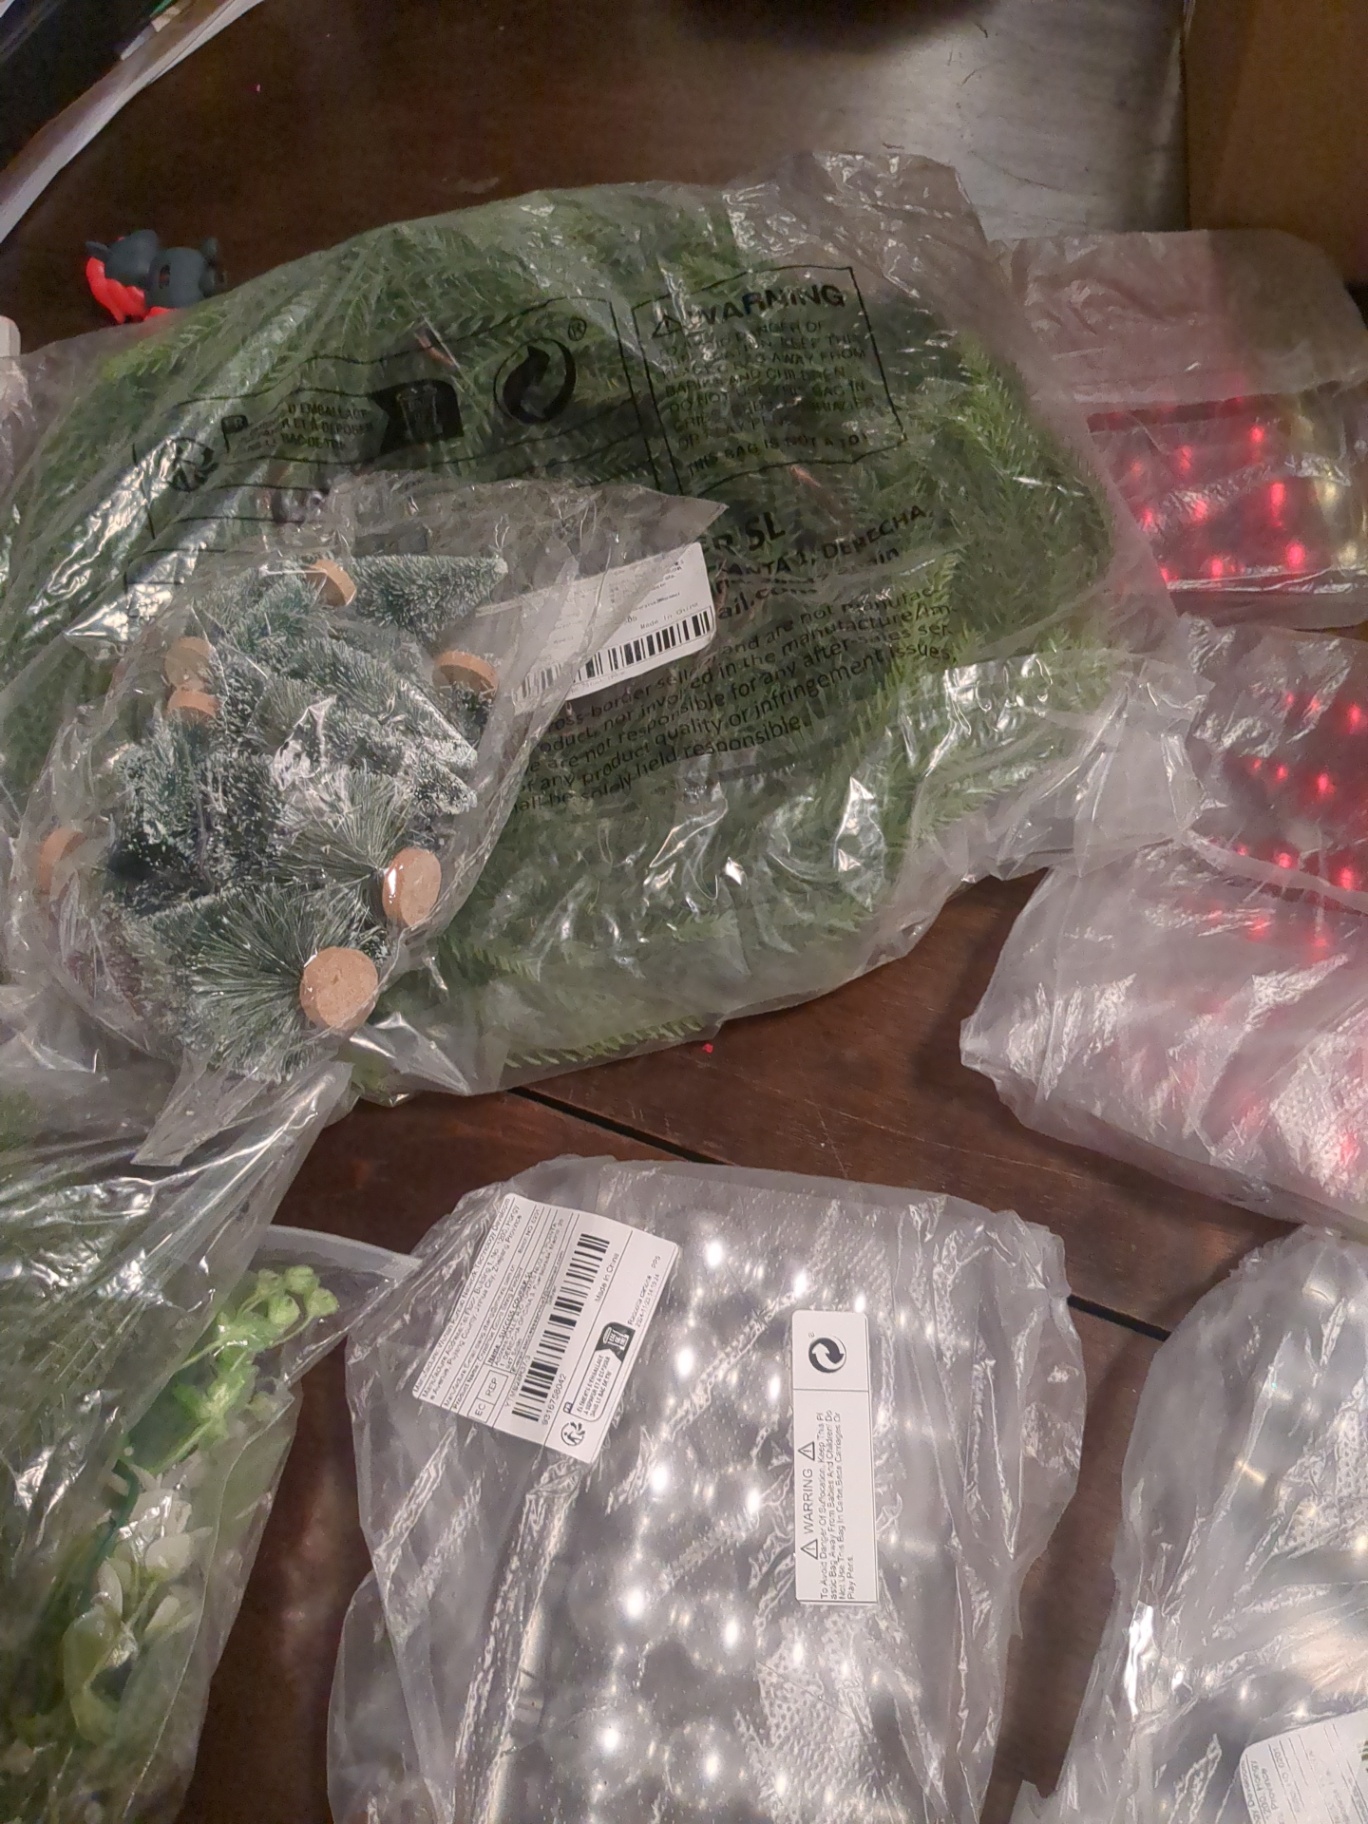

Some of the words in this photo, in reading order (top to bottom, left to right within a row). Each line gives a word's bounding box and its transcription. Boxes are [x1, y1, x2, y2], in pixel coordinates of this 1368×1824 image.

[692, 284, 846, 326] WARNING
[744, 510, 787, 553] SL
[721, 636, 759, 655] and
[766, 619, 795, 644] are
[799, 605, 835, 627] not
[617, 690, 727, 738] responsible
[730, 678, 760, 701] for
[763, 660, 798, 686] any
[640, 673, 714, 716] involed
[720, 660, 738, 680] in
[742, 650, 777, 670] the
[539, 772, 577, 793] any
[581, 741, 651, 785] product
[654, 716, 724, 748] quality
[727, 708, 750, 728] or
[754, 648, 885, 719] infringement
[473, 1401, 487, 1417] EC
[484, 1376, 500, 1397] REP
[817, 1441, 825, 1463] Keep
[802, 1468, 813, 1534] WARRING
[818, 1514, 826, 1525] Of
[827, 1509, 835, 1532] From
[820, 1587, 828, 1599] To
[847, 1580, 855, 1600] Play
